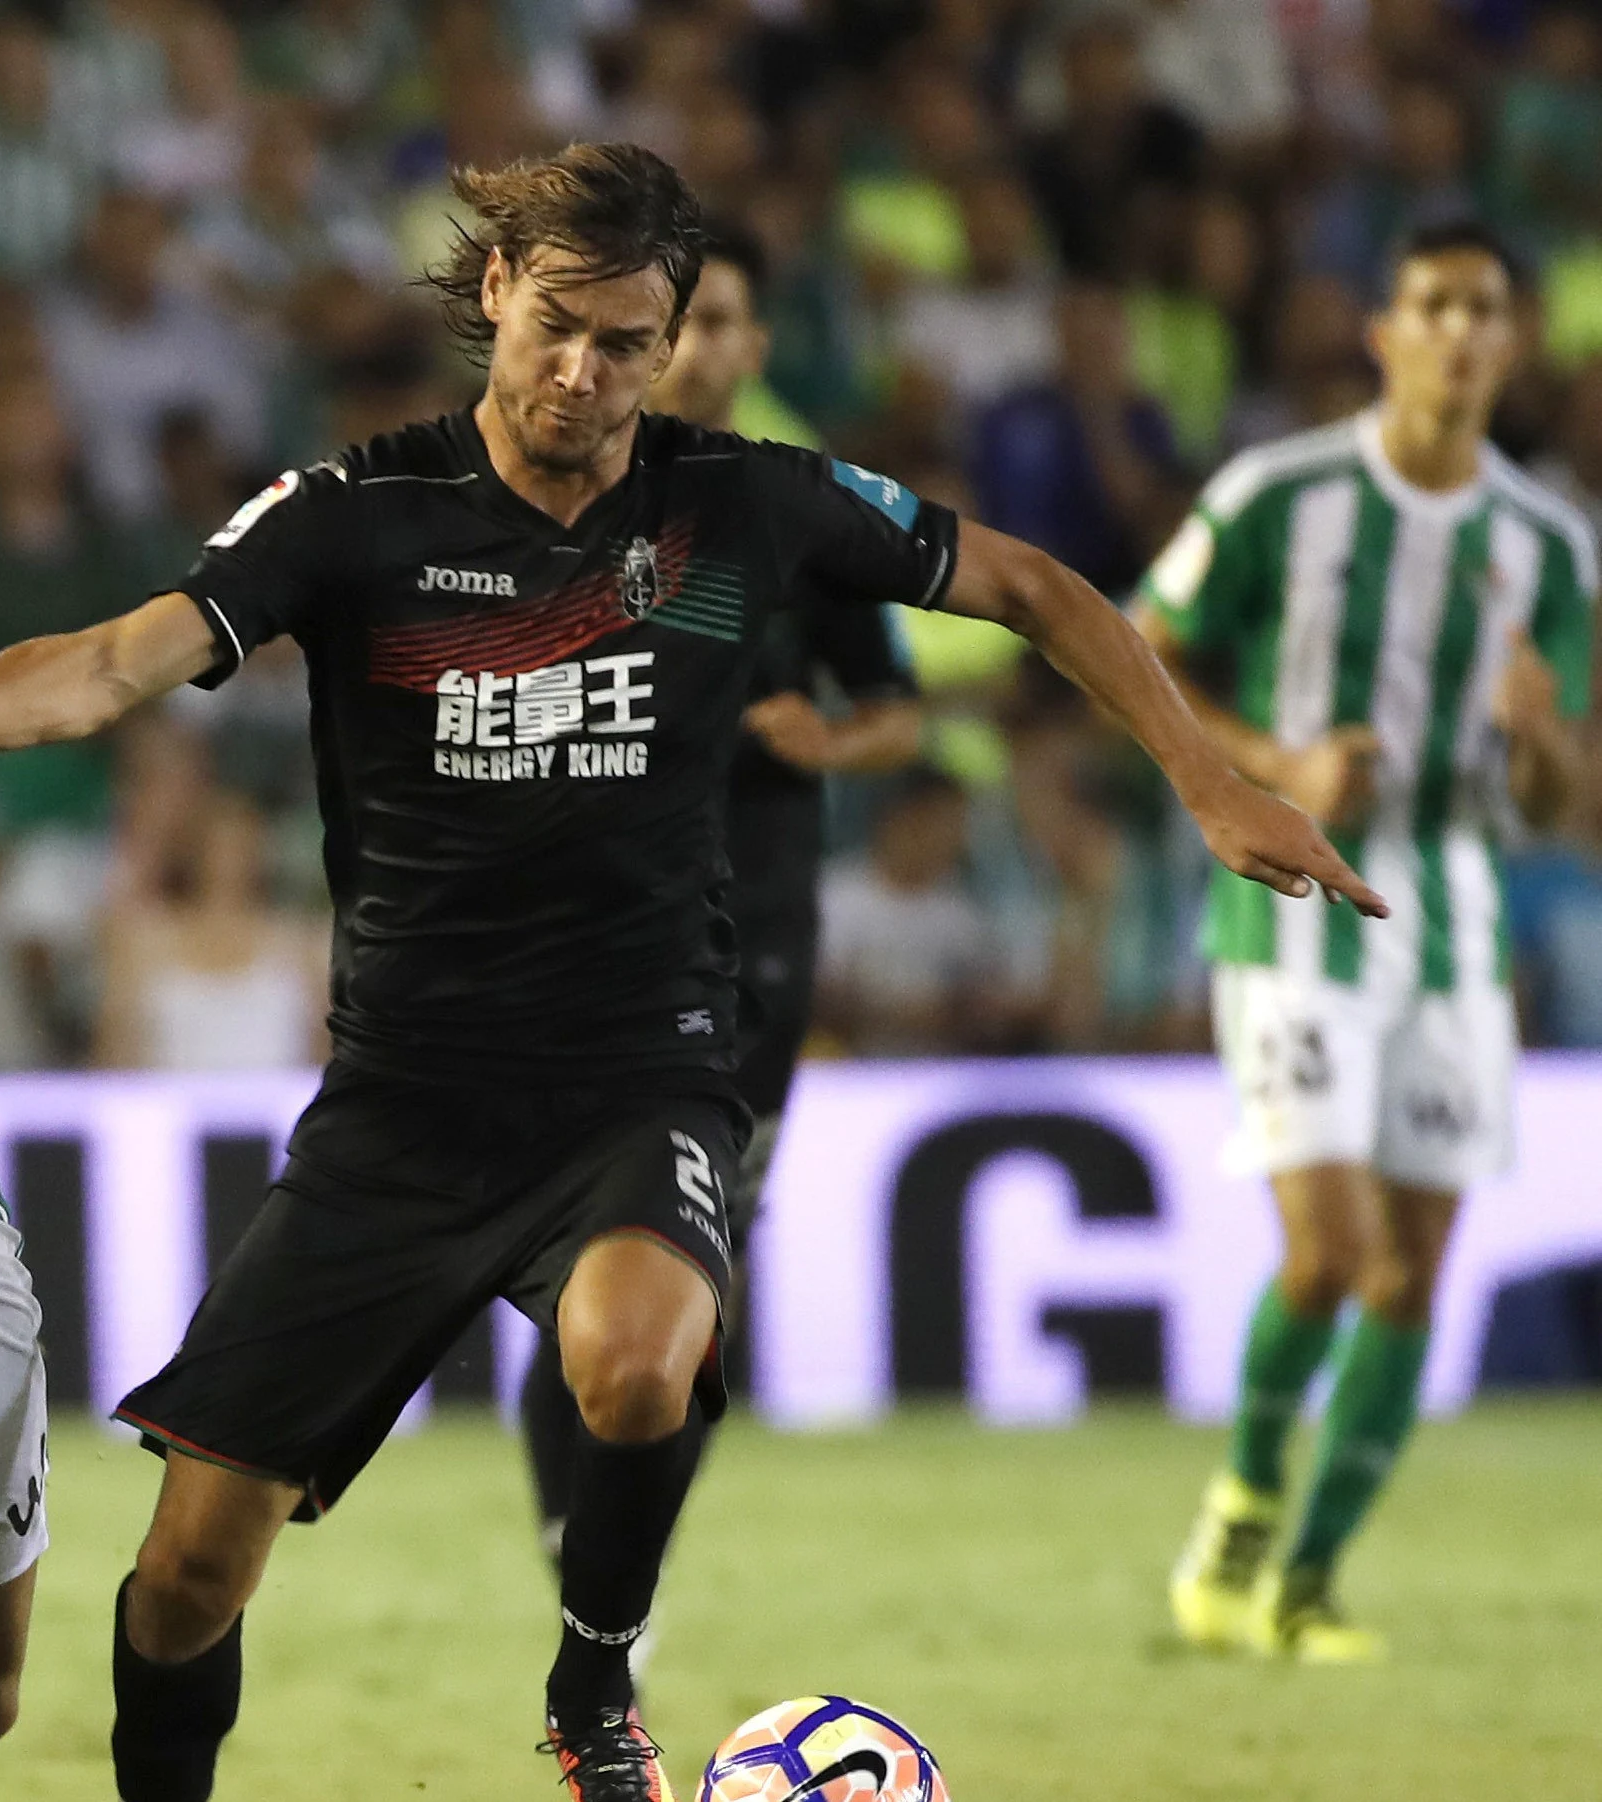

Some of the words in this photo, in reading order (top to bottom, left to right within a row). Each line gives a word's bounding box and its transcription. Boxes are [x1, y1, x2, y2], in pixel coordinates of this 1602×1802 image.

[435, 651, 657, 747] 能量王
[434, 745, 556, 782] ENERGY
[567, 741, 648, 779] KING
[669, 1129, 732, 1251] 2
